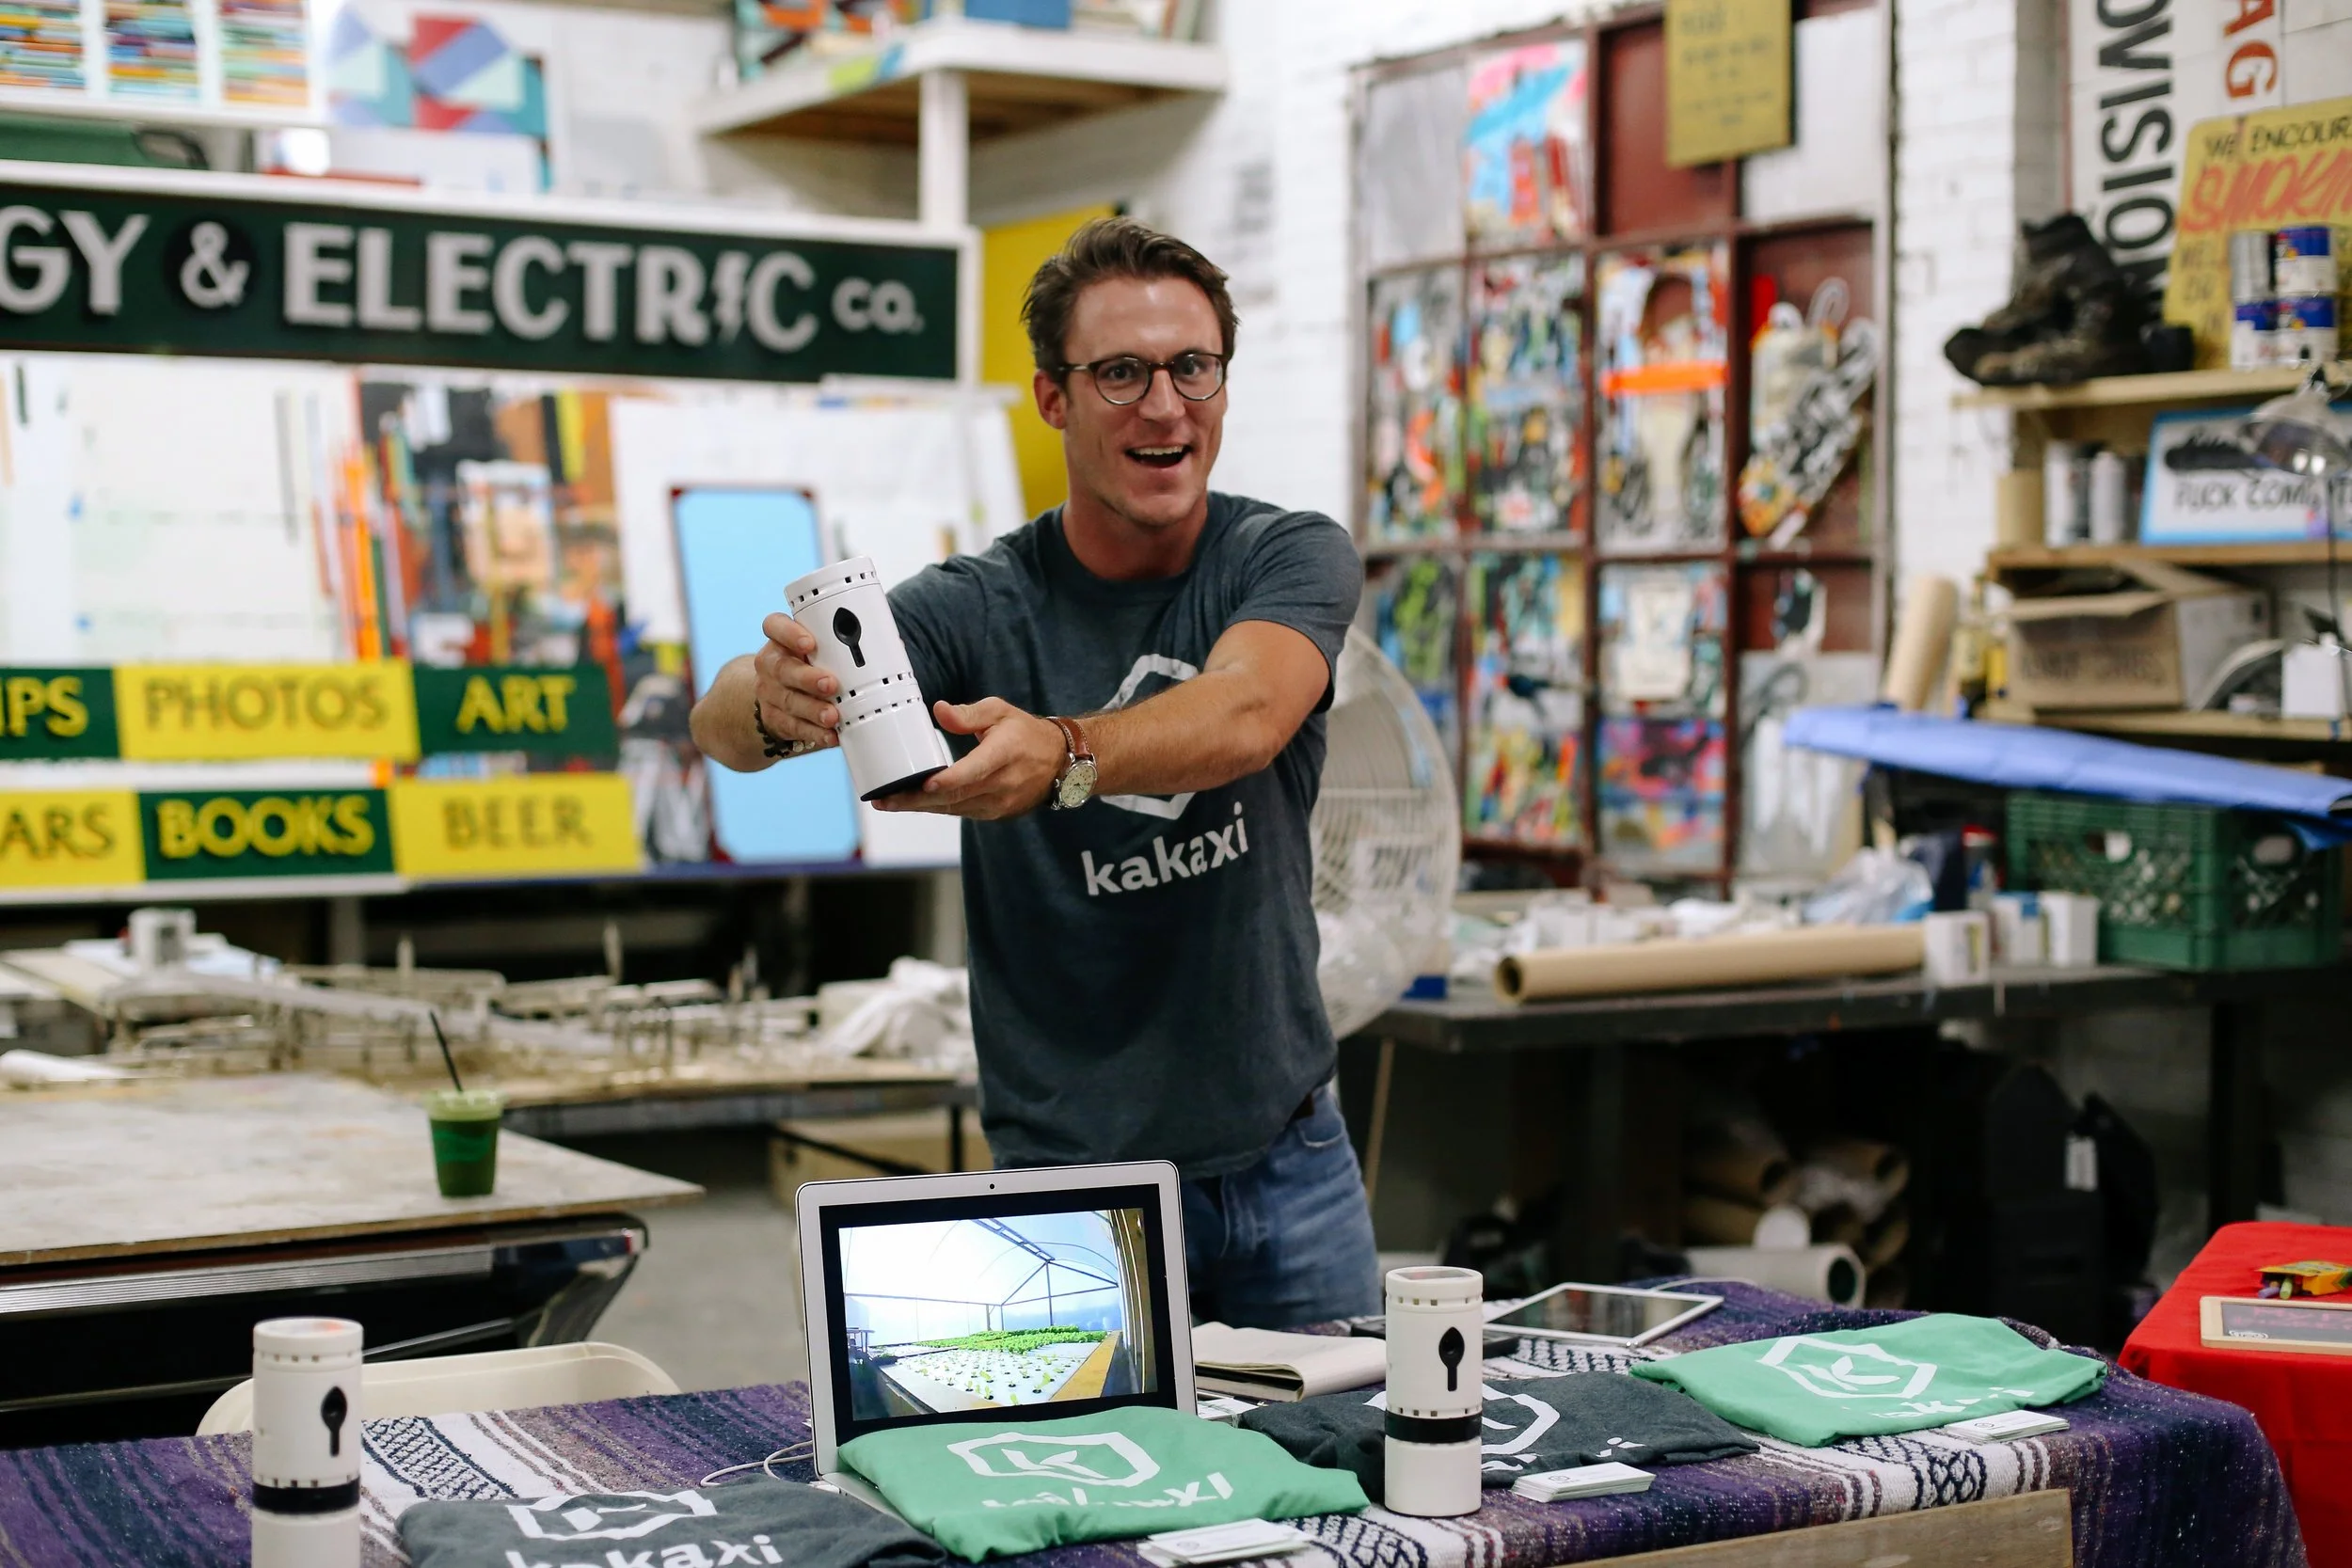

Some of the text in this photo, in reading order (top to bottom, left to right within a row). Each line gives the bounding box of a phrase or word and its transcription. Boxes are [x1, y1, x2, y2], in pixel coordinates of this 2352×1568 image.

[180, 220, 249, 309] &
[284, 222, 820, 353] ELECTRIC
[144, 675, 390, 732] PHOTOS
[456, 675, 575, 734] ART
[156, 796, 374, 857] BOOKS
[442, 796, 592, 848] BEER
[1081, 801, 1249, 896] kakaxi
[505, 1534, 783, 1568] kaxi
